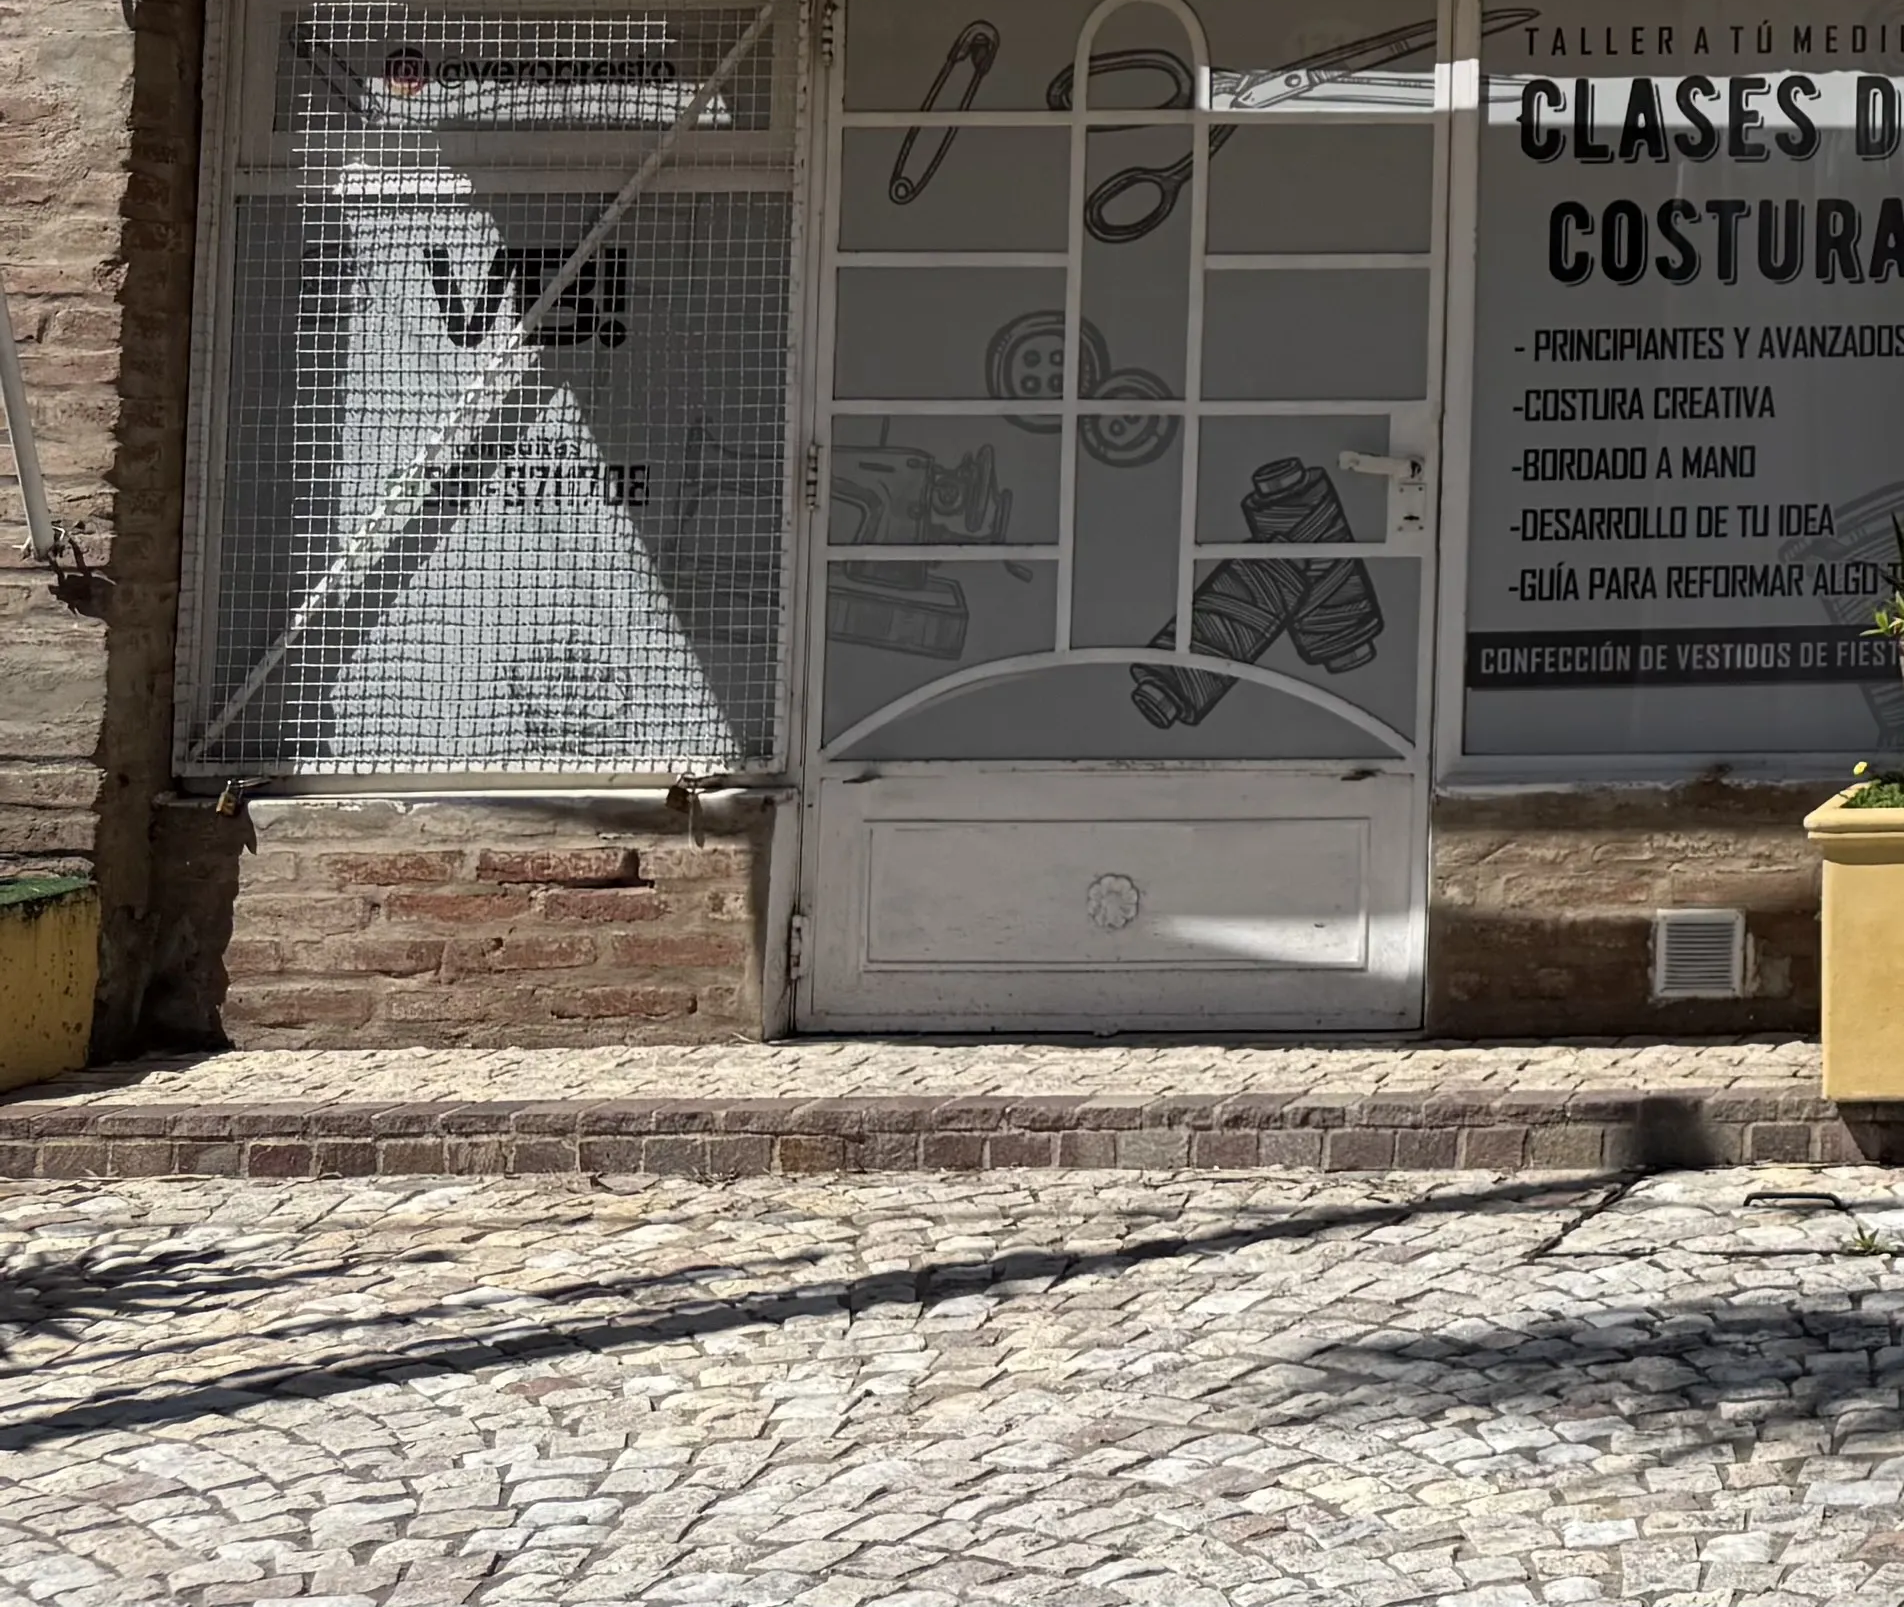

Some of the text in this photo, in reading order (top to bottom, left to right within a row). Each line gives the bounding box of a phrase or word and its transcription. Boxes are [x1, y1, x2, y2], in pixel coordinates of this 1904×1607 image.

[1525, 26, 1673, 56] TALLER
[1694, 26, 1709, 55] A
[1729, 20, 1772, 54] TÚ
[1519, 75, 1821, 163] CLASES
[1534, 327, 1724, 362] PRINCIPIANTES
[1734, 327, 1750, 360] Y
[1512, 386, 1775, 421] -COSTURA CREATIVA
[1511, 445, 1756, 481] -BORDADO A MANO
[1509, 503, 1835, 541] -DESARROLLO DE TU IDEA
[1588, 566, 1657, 600] PARA
[1667, 564, 1804, 598] REFORMAR
[1812, 563, 1878, 596] ALGO
[1480, 639, 1900, 674] CONFECCIÓN DE VESTIDOS DE FIEST
